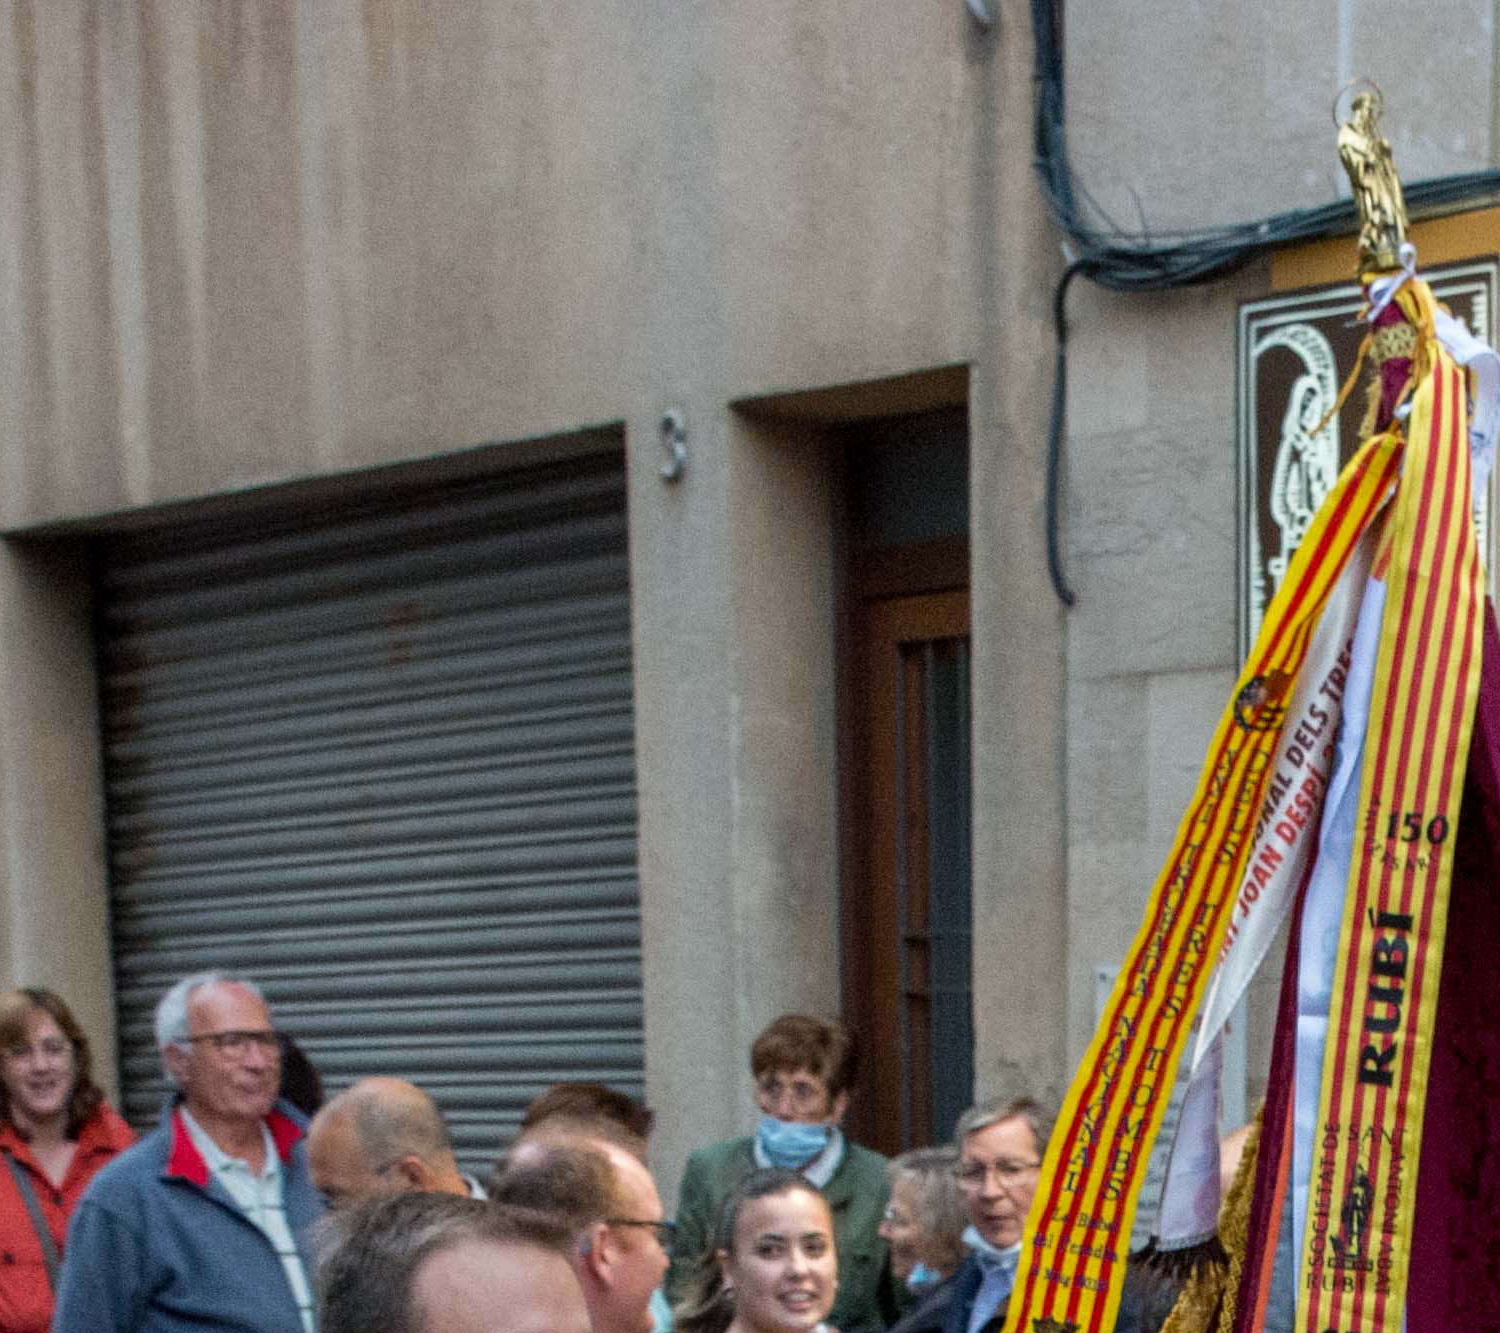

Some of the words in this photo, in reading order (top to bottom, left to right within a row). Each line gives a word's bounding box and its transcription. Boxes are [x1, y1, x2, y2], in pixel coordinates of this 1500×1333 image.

[1285, 703, 1330, 767] DELS
[1318, 637, 1355, 702] TRE
[1214, 748, 1270, 866] DELS
[1387, 811, 1449, 845] 150
[1238, 843, 1284, 920] JOAN
[1159, 901, 1218, 1020] TRES
[1357, 906, 1415, 1089] RUBÍ
[1062, 1014, 1136, 1194] NACIONAL
[1101, 1046, 1165, 1202] TOMBS
[1307, 1156, 1336, 1267] SOCIETAT
[1322, 1122, 1341, 1150] DE
